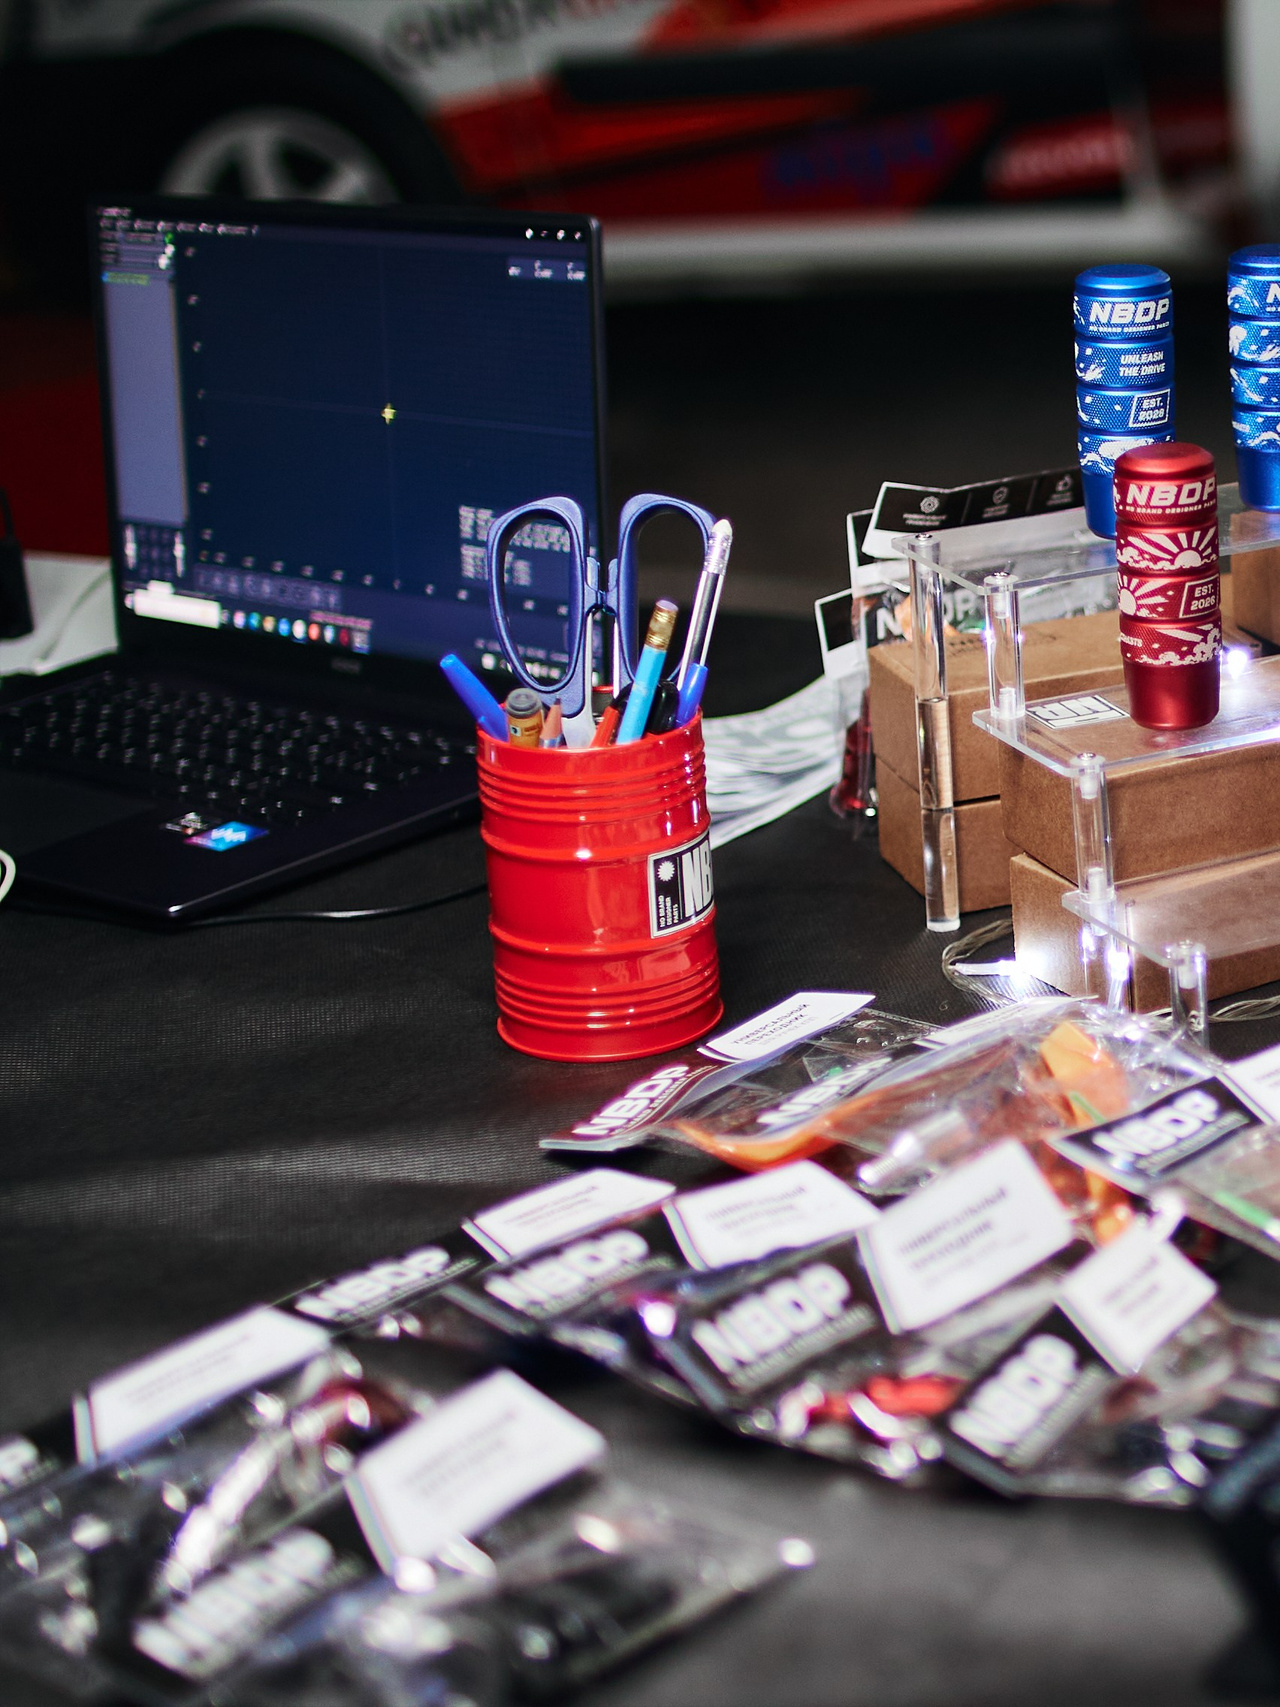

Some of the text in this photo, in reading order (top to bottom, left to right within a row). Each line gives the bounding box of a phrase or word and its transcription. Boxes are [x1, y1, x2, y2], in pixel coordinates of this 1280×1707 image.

[1089, 298, 1170, 324] NBDP
[1120, 350, 1164, 364] UNLEASH
[1119, 362, 1166, 377] THE DRIVE
[1126, 476, 1216, 506] NBDP
[1194, 583, 1214, 597] EST.
[1190, 595, 1216, 611] 2026
[571, 1066, 690, 1135] NBDP
[692, 1263, 850, 1374] NBDP
